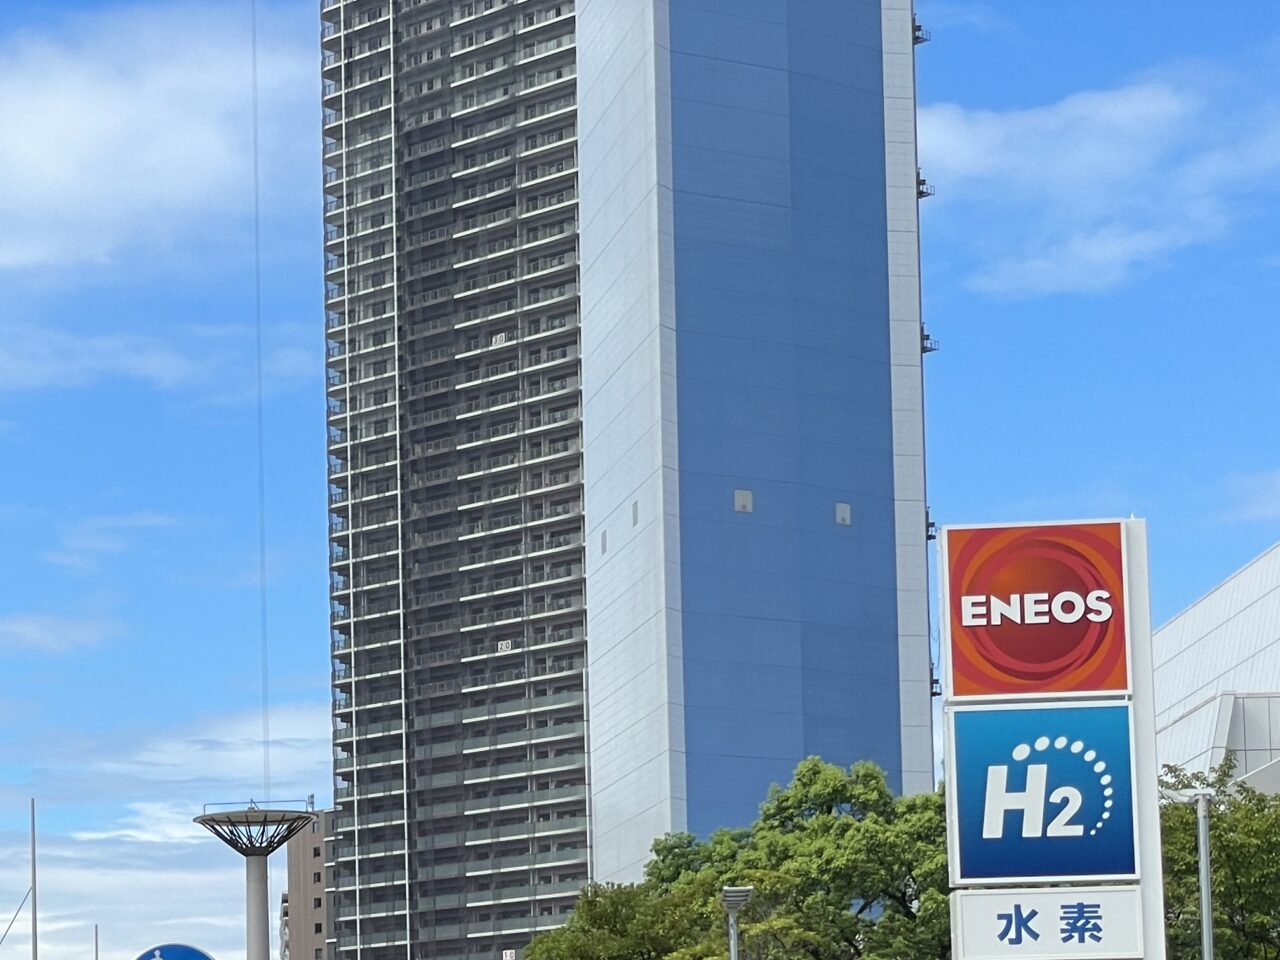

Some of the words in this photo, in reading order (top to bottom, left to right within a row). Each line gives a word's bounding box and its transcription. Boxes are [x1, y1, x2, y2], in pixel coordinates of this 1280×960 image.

[961, 589, 1113, 627] ENEOS
[982, 764, 1084, 839] H2
[996, 902, 1103, 945] 水素
